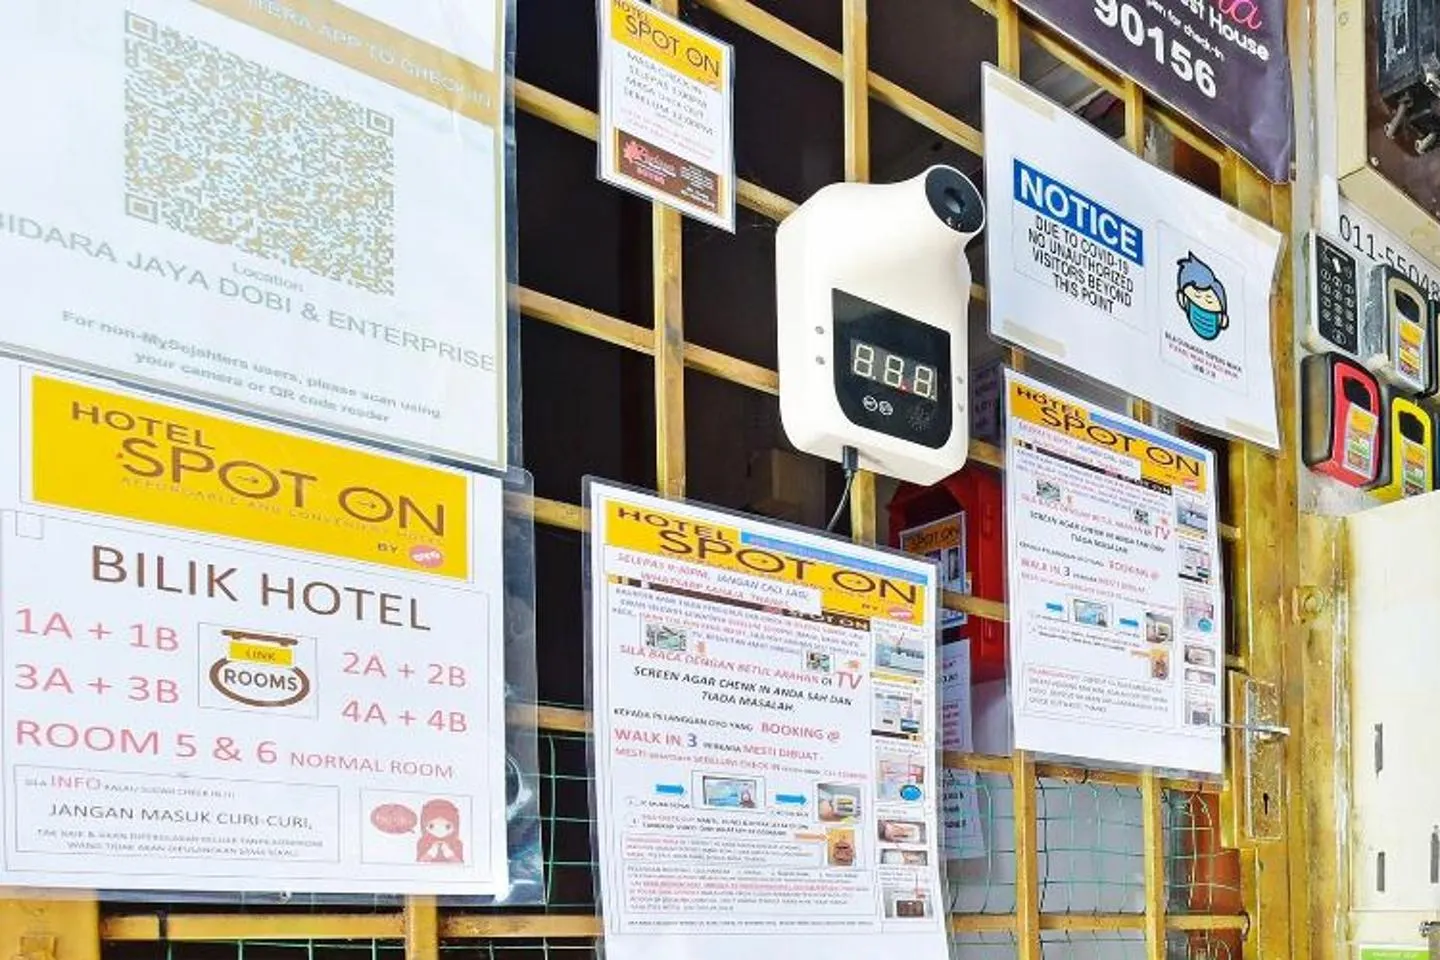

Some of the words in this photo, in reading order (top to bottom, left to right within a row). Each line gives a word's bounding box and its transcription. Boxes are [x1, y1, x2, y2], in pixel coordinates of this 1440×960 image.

[625, 13, 680, 56] SPOT
[687, 47, 720, 78] ON
[1094, 0, 1216, 98] 90156
[1210, 6, 1270, 61] House
[1020, 169, 1139, 259] NOTICE
[1028, 228, 1046, 249] NO
[1049, 239, 1135, 292] UNAUTHORIZED
[1035, 215, 1060, 239] DUE
[1064, 229, 1078, 248] TO
[1080, 237, 1130, 275] COVID-19
[232, 260, 304, 293] Location
[1032, 248, 1086, 284] VISITORS
[1088, 277, 1133, 308] BEYOND
[1053, 273, 1079, 299] THIS
[1082, 290, 1115, 314] POINT
[62, 310, 94, 330] For
[127, 252, 210, 290] JAYA
[218, 275, 292, 314] DOBI
[301, 302, 321, 322] &
[328, 310, 495, 373] ENTERPRISE
[134, 351, 175, 377] your
[269, 384, 295, 403] QR
[71, 401, 216, 451] HOTEL
[1041, 405, 1135, 452] SPOT
[1146, 446, 1199, 477] ON
[120, 436, 318, 508] SPOT
[337, 485, 446, 538] ON
[121, 475, 239, 507] AFFORDABLE
[247, 498, 282, 515] AND
[617, 506, 735, 543] HOTEL
[1154, 525, 1171, 541] TV
[92, 544, 238, 603] BILIK
[260, 572, 431, 632] HOTEL
[659, 529, 818, 582] SPOT
[833, 570, 917, 605] ON
[15, 608, 74, 641] 1A
[87, 623, 111, 641] +
[129, 622, 180, 653] 1B
[15, 663, 73, 694] 3A
[87, 676, 111, 696] +
[128, 676, 180, 704] 3B
[224, 668, 298, 692] ROOMS
[342, 652, 387, 678] 2A
[397, 659, 415, 678] +
[428, 662, 466, 688] 2B
[620, 643, 648, 659] SILA
[650, 648, 683, 664] BACA
[684, 653, 735, 671] DENGAN
[836, 670, 862, 690] TV
[633, 666, 680, 683] SCREEN
[683, 672, 717, 688] AGAR
[771, 685, 805, 700] ANDA
[807, 689, 829, 703] SAH
[831, 693, 852, 707] DAN
[342, 700, 387, 725] 4A
[398, 710, 416, 727] +
[427, 709, 467, 733] 4B
[701, 691, 737, 706] TIADA
[15, 720, 159, 756] ROOM
[175, 734, 198, 759] 5
[211, 737, 242, 763] &
[257, 740, 279, 765] 6
[289, 751, 384, 774] NORMAL
[390, 757, 454, 780] ROOM
[614, 727, 660, 747] WALK
[687, 732, 698, 748] 3
[761, 721, 825, 741] BOOKING
[50, 774, 101, 791] INFO
[49, 803, 135, 821] JANGAN
[141, 806, 211, 824] MASUK
